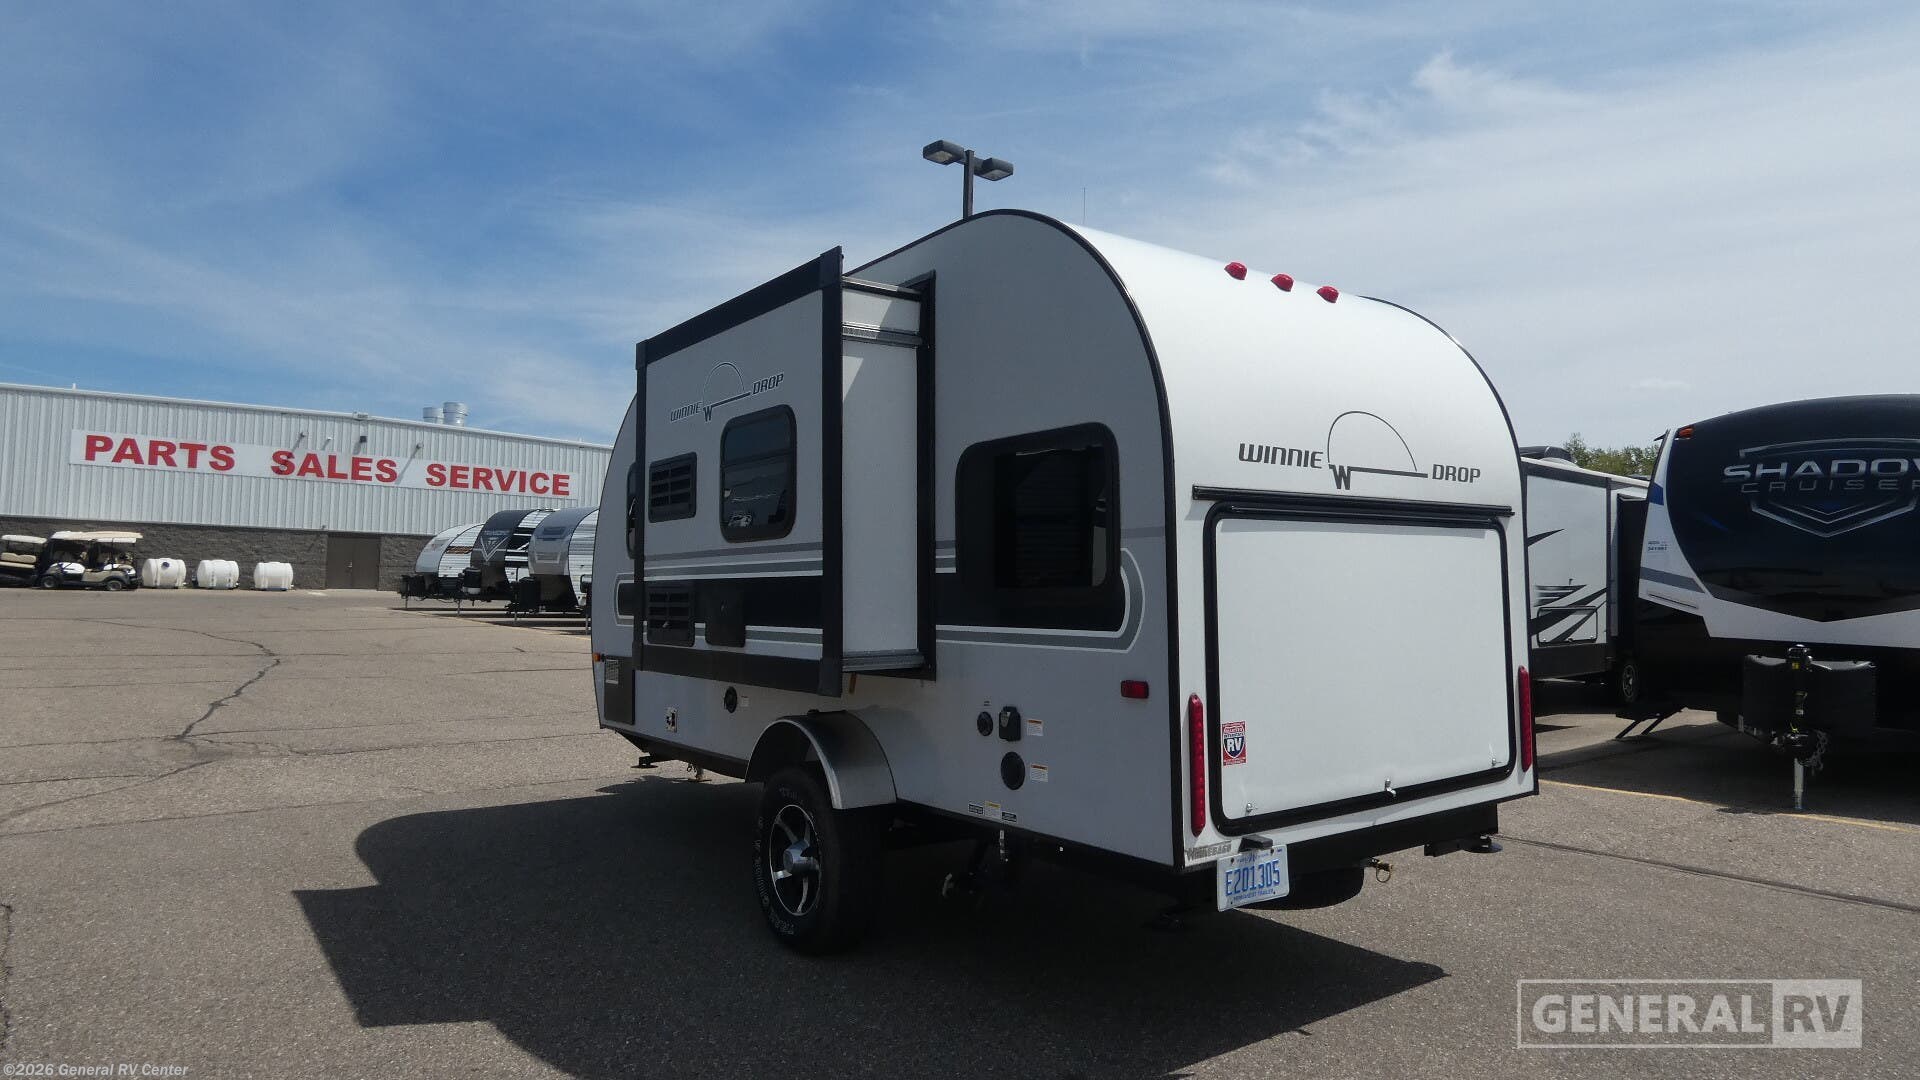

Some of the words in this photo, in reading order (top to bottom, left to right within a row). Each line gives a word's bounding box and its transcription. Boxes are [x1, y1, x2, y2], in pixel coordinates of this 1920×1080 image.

[670, 401, 702, 423] WINNIE
[752, 373, 785, 395] DROP
[84, 434, 236, 471] PARTS
[270, 449, 398, 483] SALES
[425, 463, 570, 496] SERVICE
[1238, 443, 1324, 469] WINNIE
[1432, 463, 1481, 484] DROP
[1226, 737, 1243, 752] RV
[1225, 859, 1280, 896] E201305
